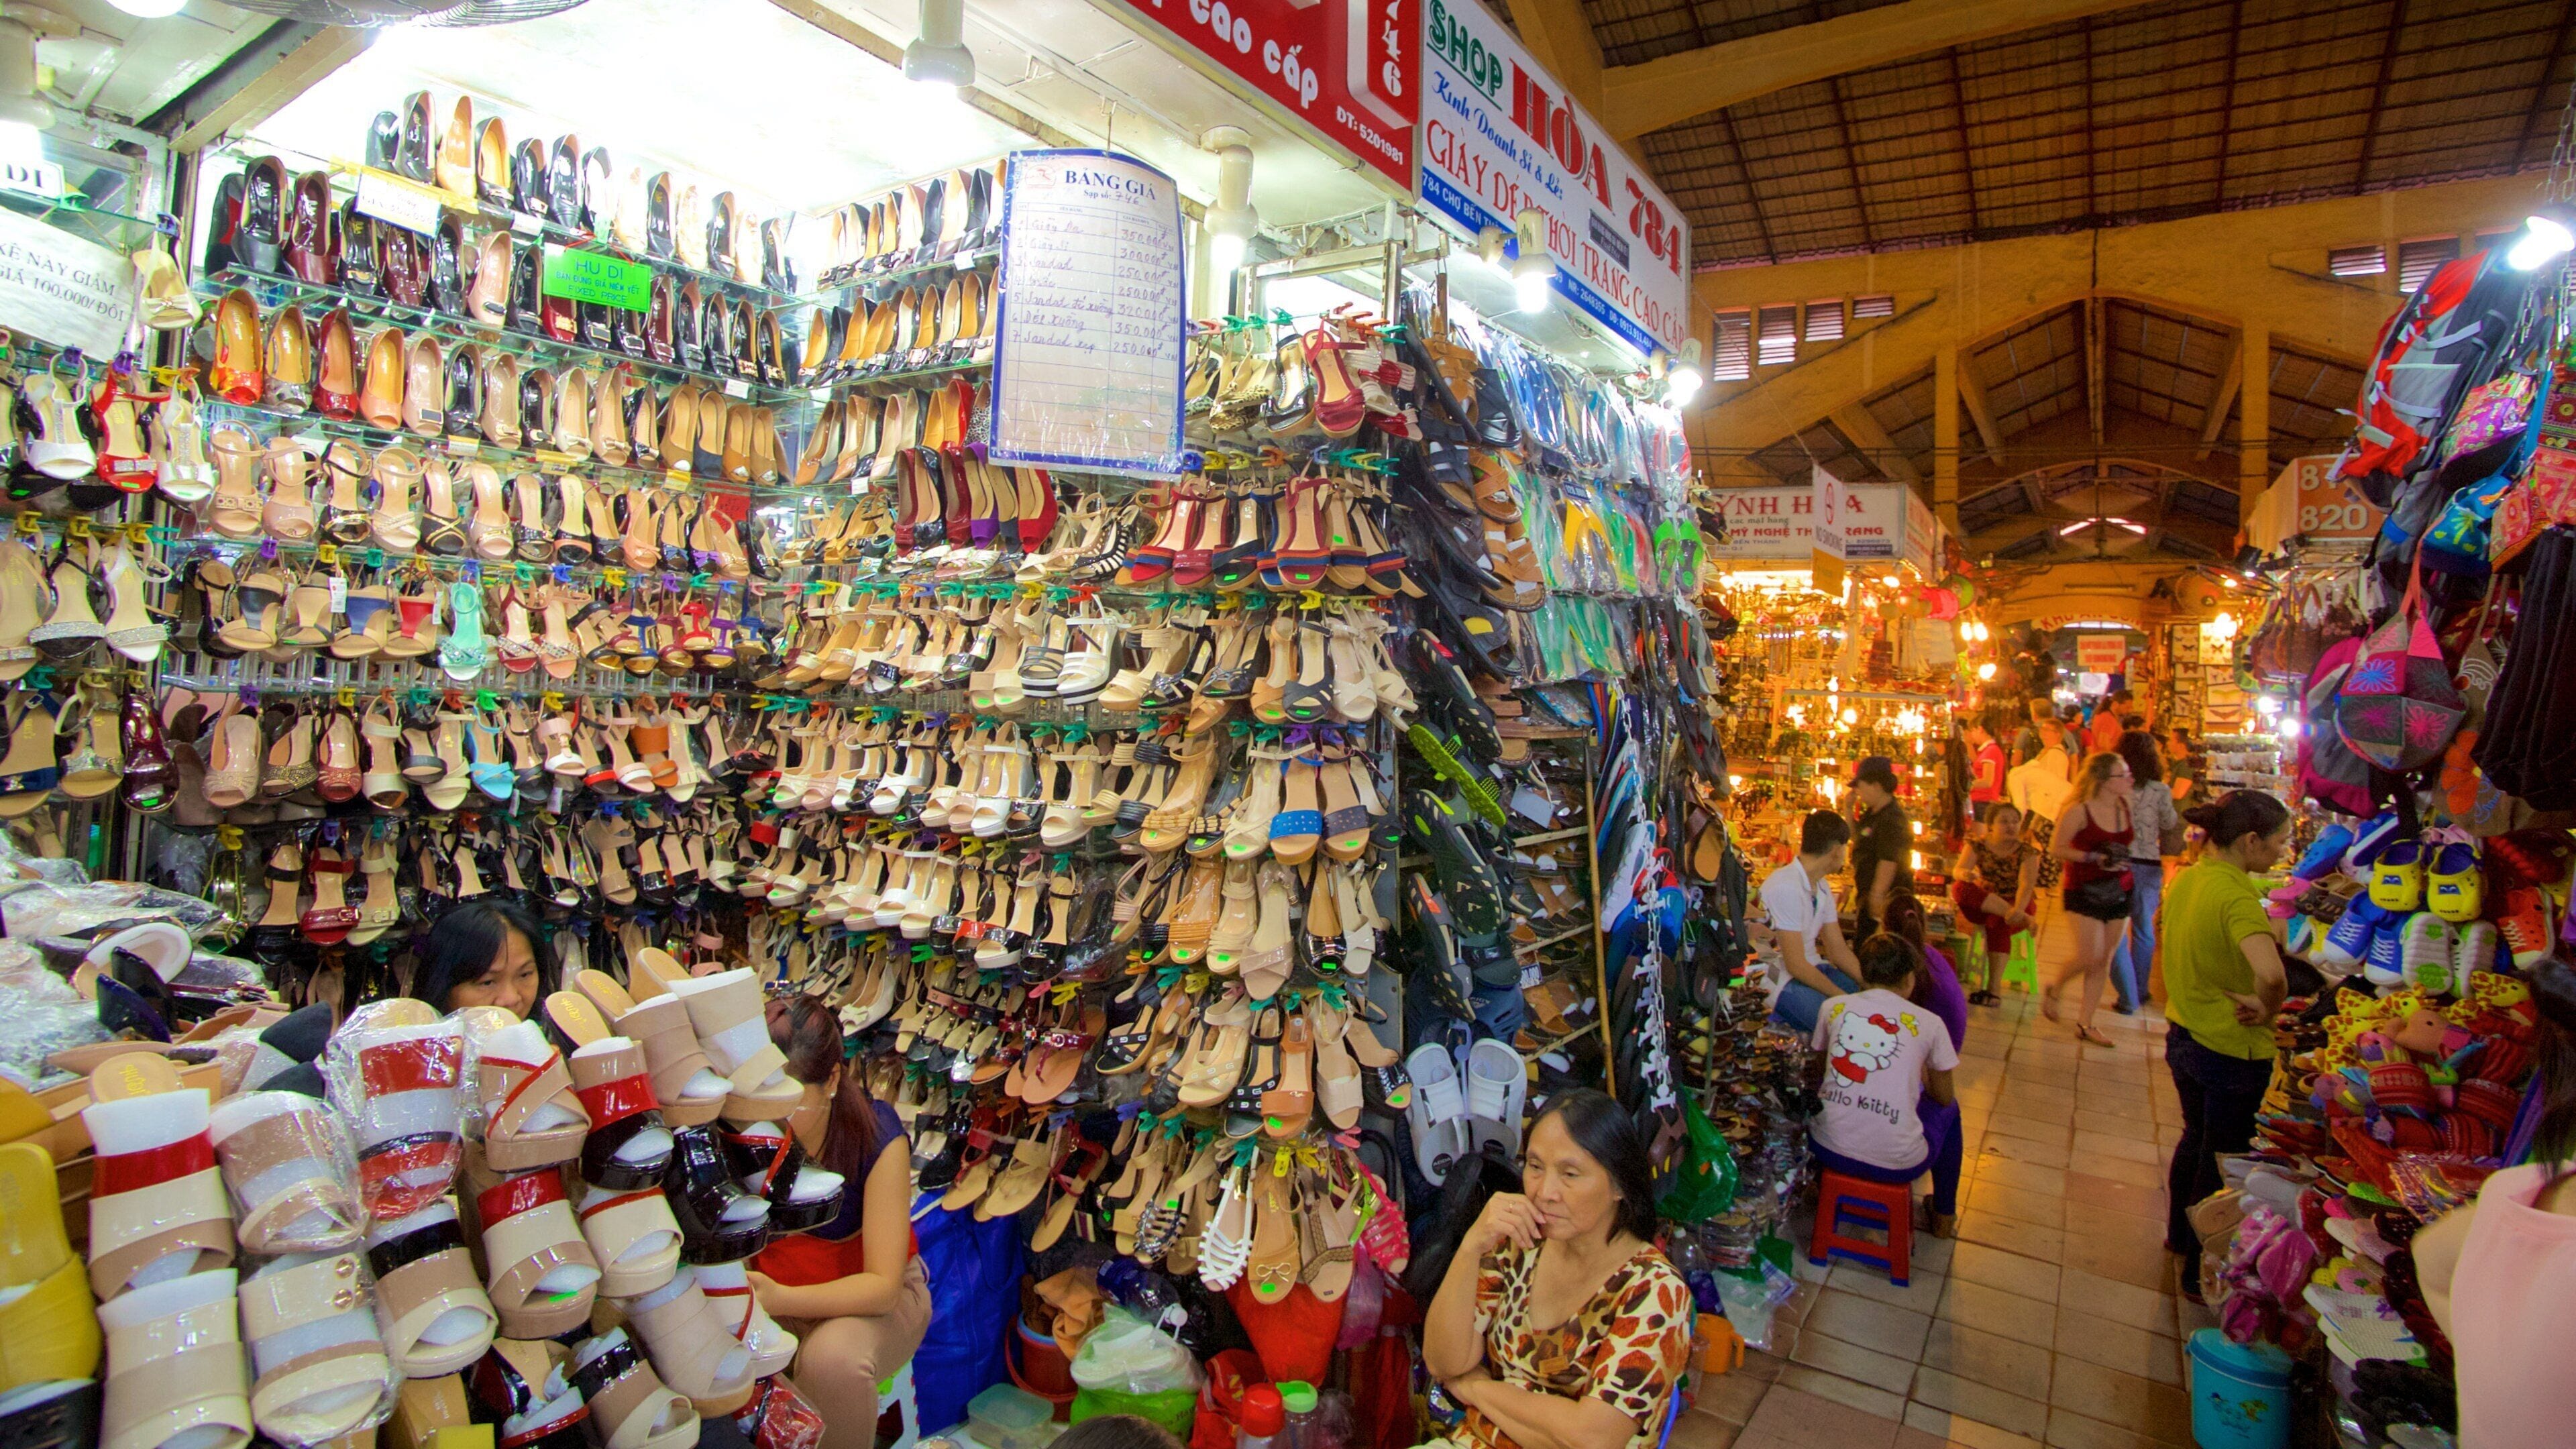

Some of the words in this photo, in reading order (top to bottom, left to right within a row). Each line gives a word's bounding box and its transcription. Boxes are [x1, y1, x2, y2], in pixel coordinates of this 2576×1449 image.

[1189, 0, 1252, 54] cao
[1263, 39, 1319, 110] cấp
[1429, 0, 1503, 97] SHOP
[1358, 126, 1404, 165] 5201981
[1474, 107, 1517, 164] Doanh
[1535, 162, 1543, 181] &
[1065, 167, 1120, 191] BẢNG
[1126, 179, 1157, 201] GIÁ
[1509, 56, 1615, 217] HÒA
[1625, 172, 1683, 280] 784
[1083, 190, 1099, 202] Sạp
[1114, 191, 1142, 206] 746
[1422, 172, 1440, 196] 784
[1442, 186, 1462, 213] CHỢ
[1463, 203, 1482, 225] BẾN
[1426, 119, 1487, 196] GIÀY
[1581, 240, 1631, 309] TRANG
[1633, 286, 1660, 333] CAO
[27, 251, 69, 278] NÀY
[73, 270, 116, 297] GIẢM
[575, 258, 600, 275] HU
[607, 265, 624, 280] DI
[96, 300, 125, 323] ĐÔI
[568, 285, 596, 298] FIXED
[601, 292, 628, 303] PRICE
[1845, 527, 1884, 536] RANG
[2299, 504, 2368, 532] 820
[1857, 1095, 1900, 1125] Kitty
